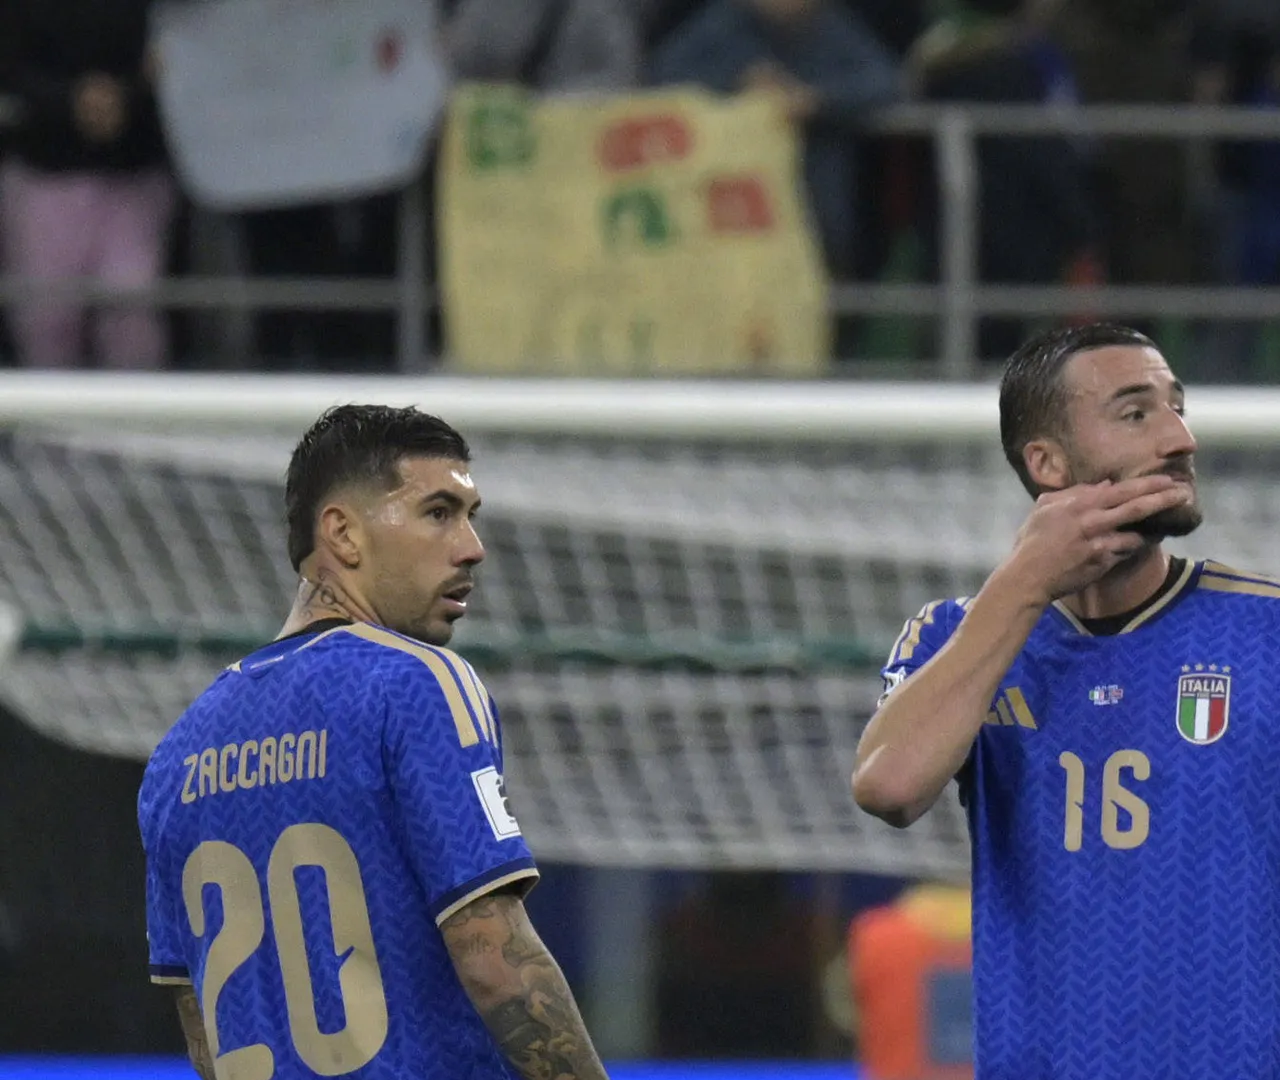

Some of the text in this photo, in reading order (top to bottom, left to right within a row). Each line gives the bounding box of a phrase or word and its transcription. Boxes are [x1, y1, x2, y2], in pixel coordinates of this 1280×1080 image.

[1181, 679, 1226, 693] ITALIA
[180, 729, 328, 804] ZACCAGNI
[1058, 749, 1152, 853] 16
